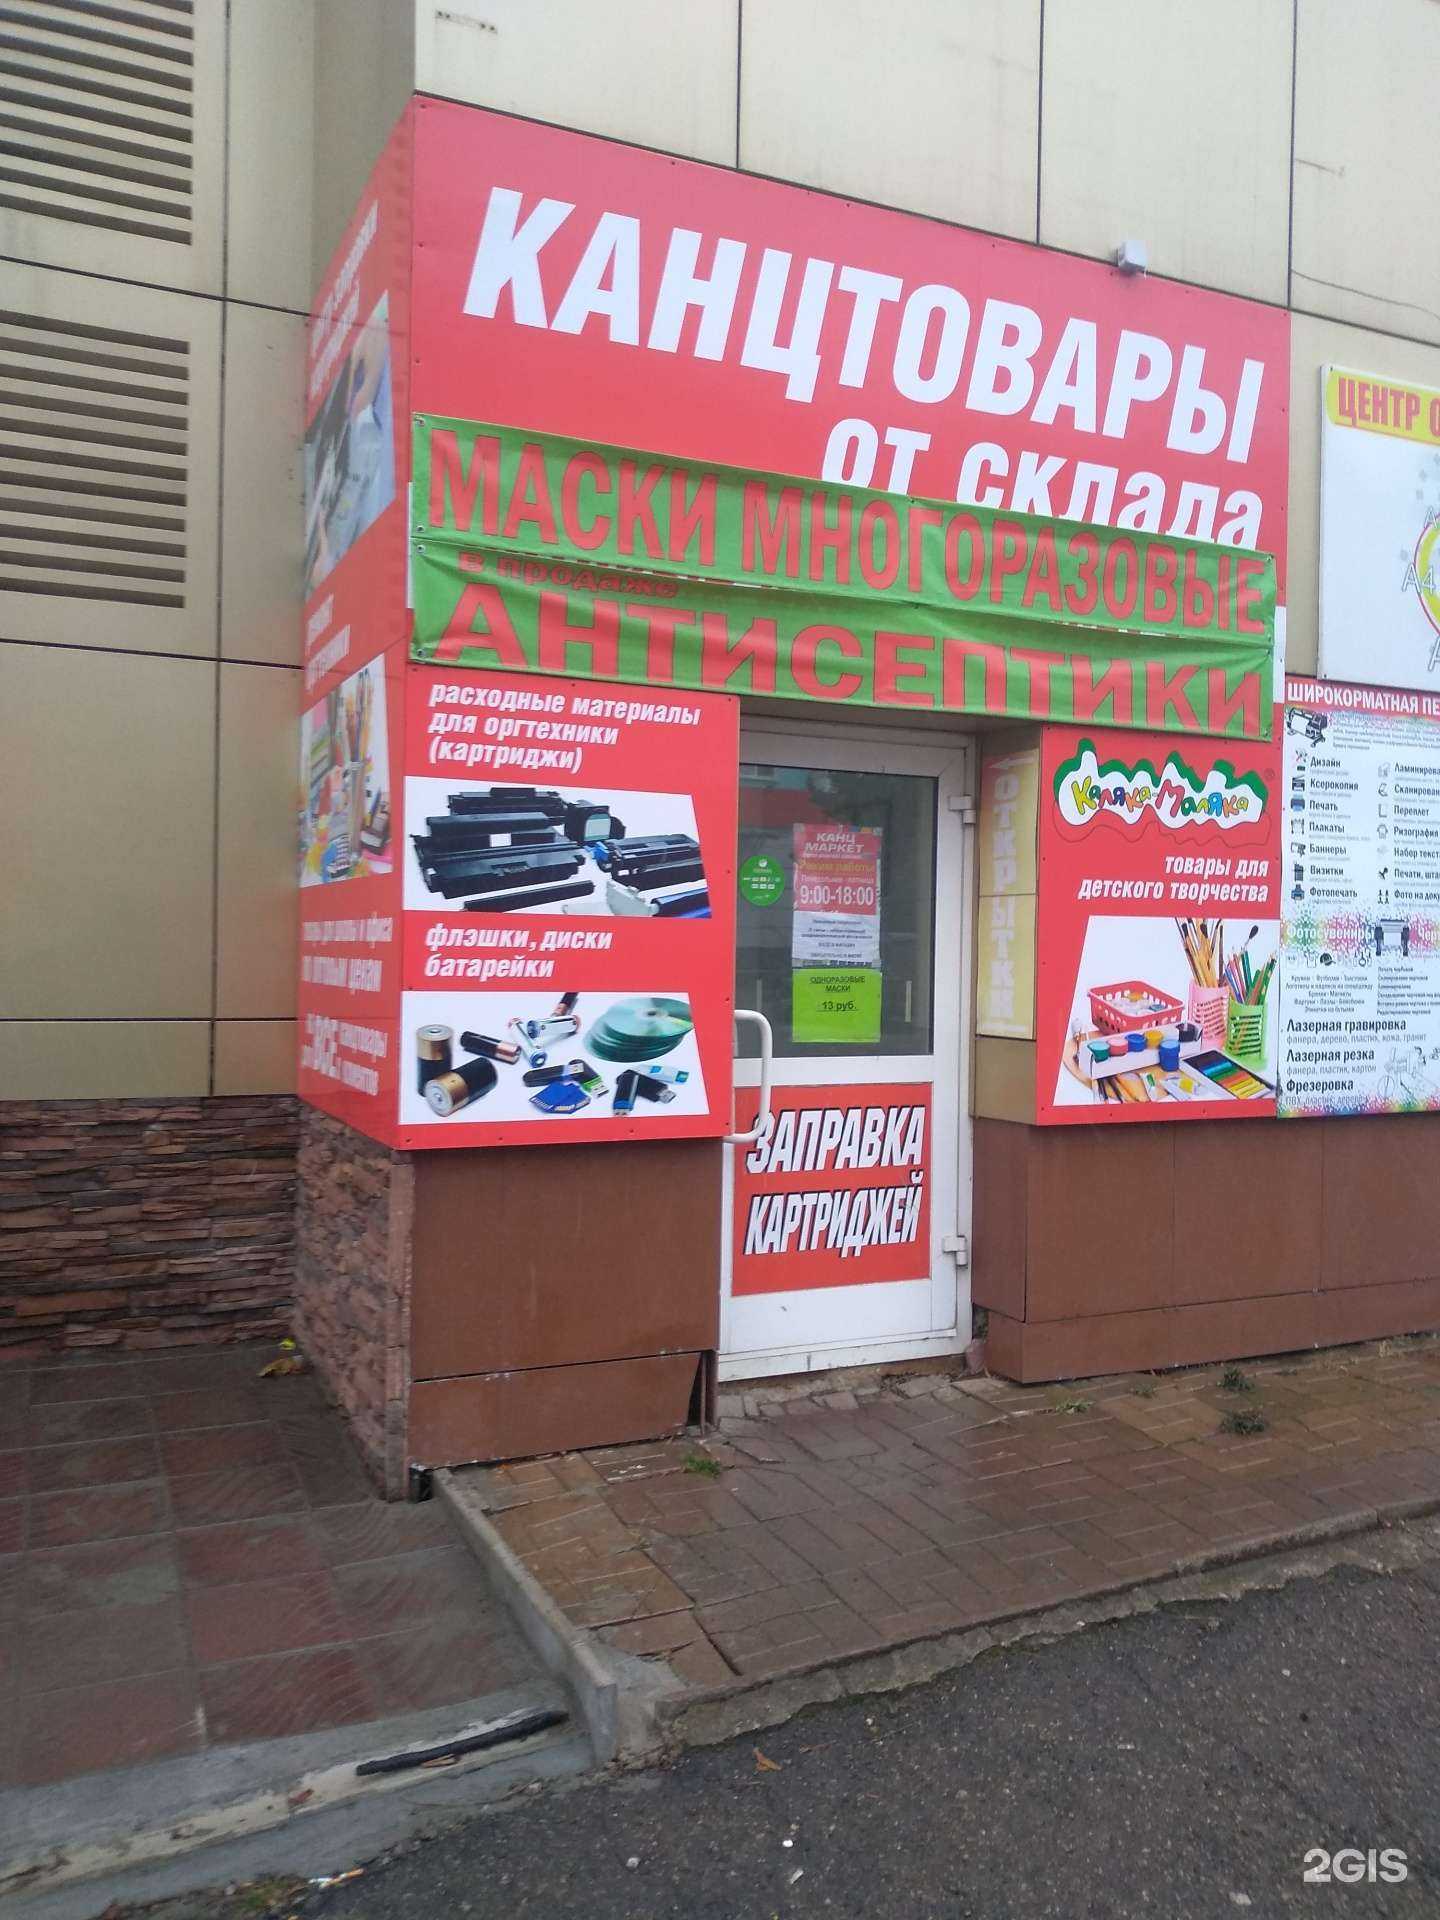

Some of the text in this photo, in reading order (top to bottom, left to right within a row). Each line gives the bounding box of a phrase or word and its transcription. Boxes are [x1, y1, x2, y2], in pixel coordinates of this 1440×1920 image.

[463, 187, 1265, 464] КАНЦТОВАРЫ
[1338, 377, 1421, 432] ЦЕНТР
[956, 442, 1264, 551] склада
[428, 429, 1266, 635] МАСКИ МНОГОРАЗОВЫЕ
[496, 556, 679, 599] продаже
[431, 583, 1262, 737] АНТИСЕПТИКИ
[428, 683, 701, 726] расходные материалы
[1287, 682, 1440, 717] ШИРОКОРМАТНАЯ ПЕ
[427, 712, 619, 746] для оргтехники
[428, 735, 584, 775] (картриджи)
[1310, 756, 1342, 768] Дизайн
[1310, 778, 1360, 791] Ксерокопия
[1309, 800, 1339, 812] Печать
[1394, 804, 1430, 817] Переплет
[1309, 821, 1345, 834] Плакаты
[1393, 825, 1439, 839] Ризография
[816, 832, 857, 846] КАНЦ
[805, 842, 865, 854] МАРКЕТ
[1309, 843, 1347, 856] Баннеры
[1394, 847, 1440, 860] Набор текст
[1165, 855, 1269, 880] товары для
[1310, 864, 1344, 876] Визитки
[800, 884, 874, 906] 9:00-18:00
[1077, 879, 1269, 906] детского творчества
[1309, 886, 1358, 899] Фотопечать
[1394, 889, 1413, 900] Фото
[425, 923, 537, 952] флэшки,
[540, 928, 613, 951] диски
[424, 951, 554, 982] батарейки
[824, 985, 851, 993] МАСКИ
[822, 1000, 857, 1012] 13 руб.
[1287, 1018, 1407, 1035] Лазерная гравировка
[1287, 1049, 1375, 1064] Лазерная резка
[1286, 1079, 1354, 1095] Фрезеровка
[745, 1104, 927, 1175] ЗАПРАВКА
[742, 1168, 925, 1259] КАРТРИДЖЕЙ
